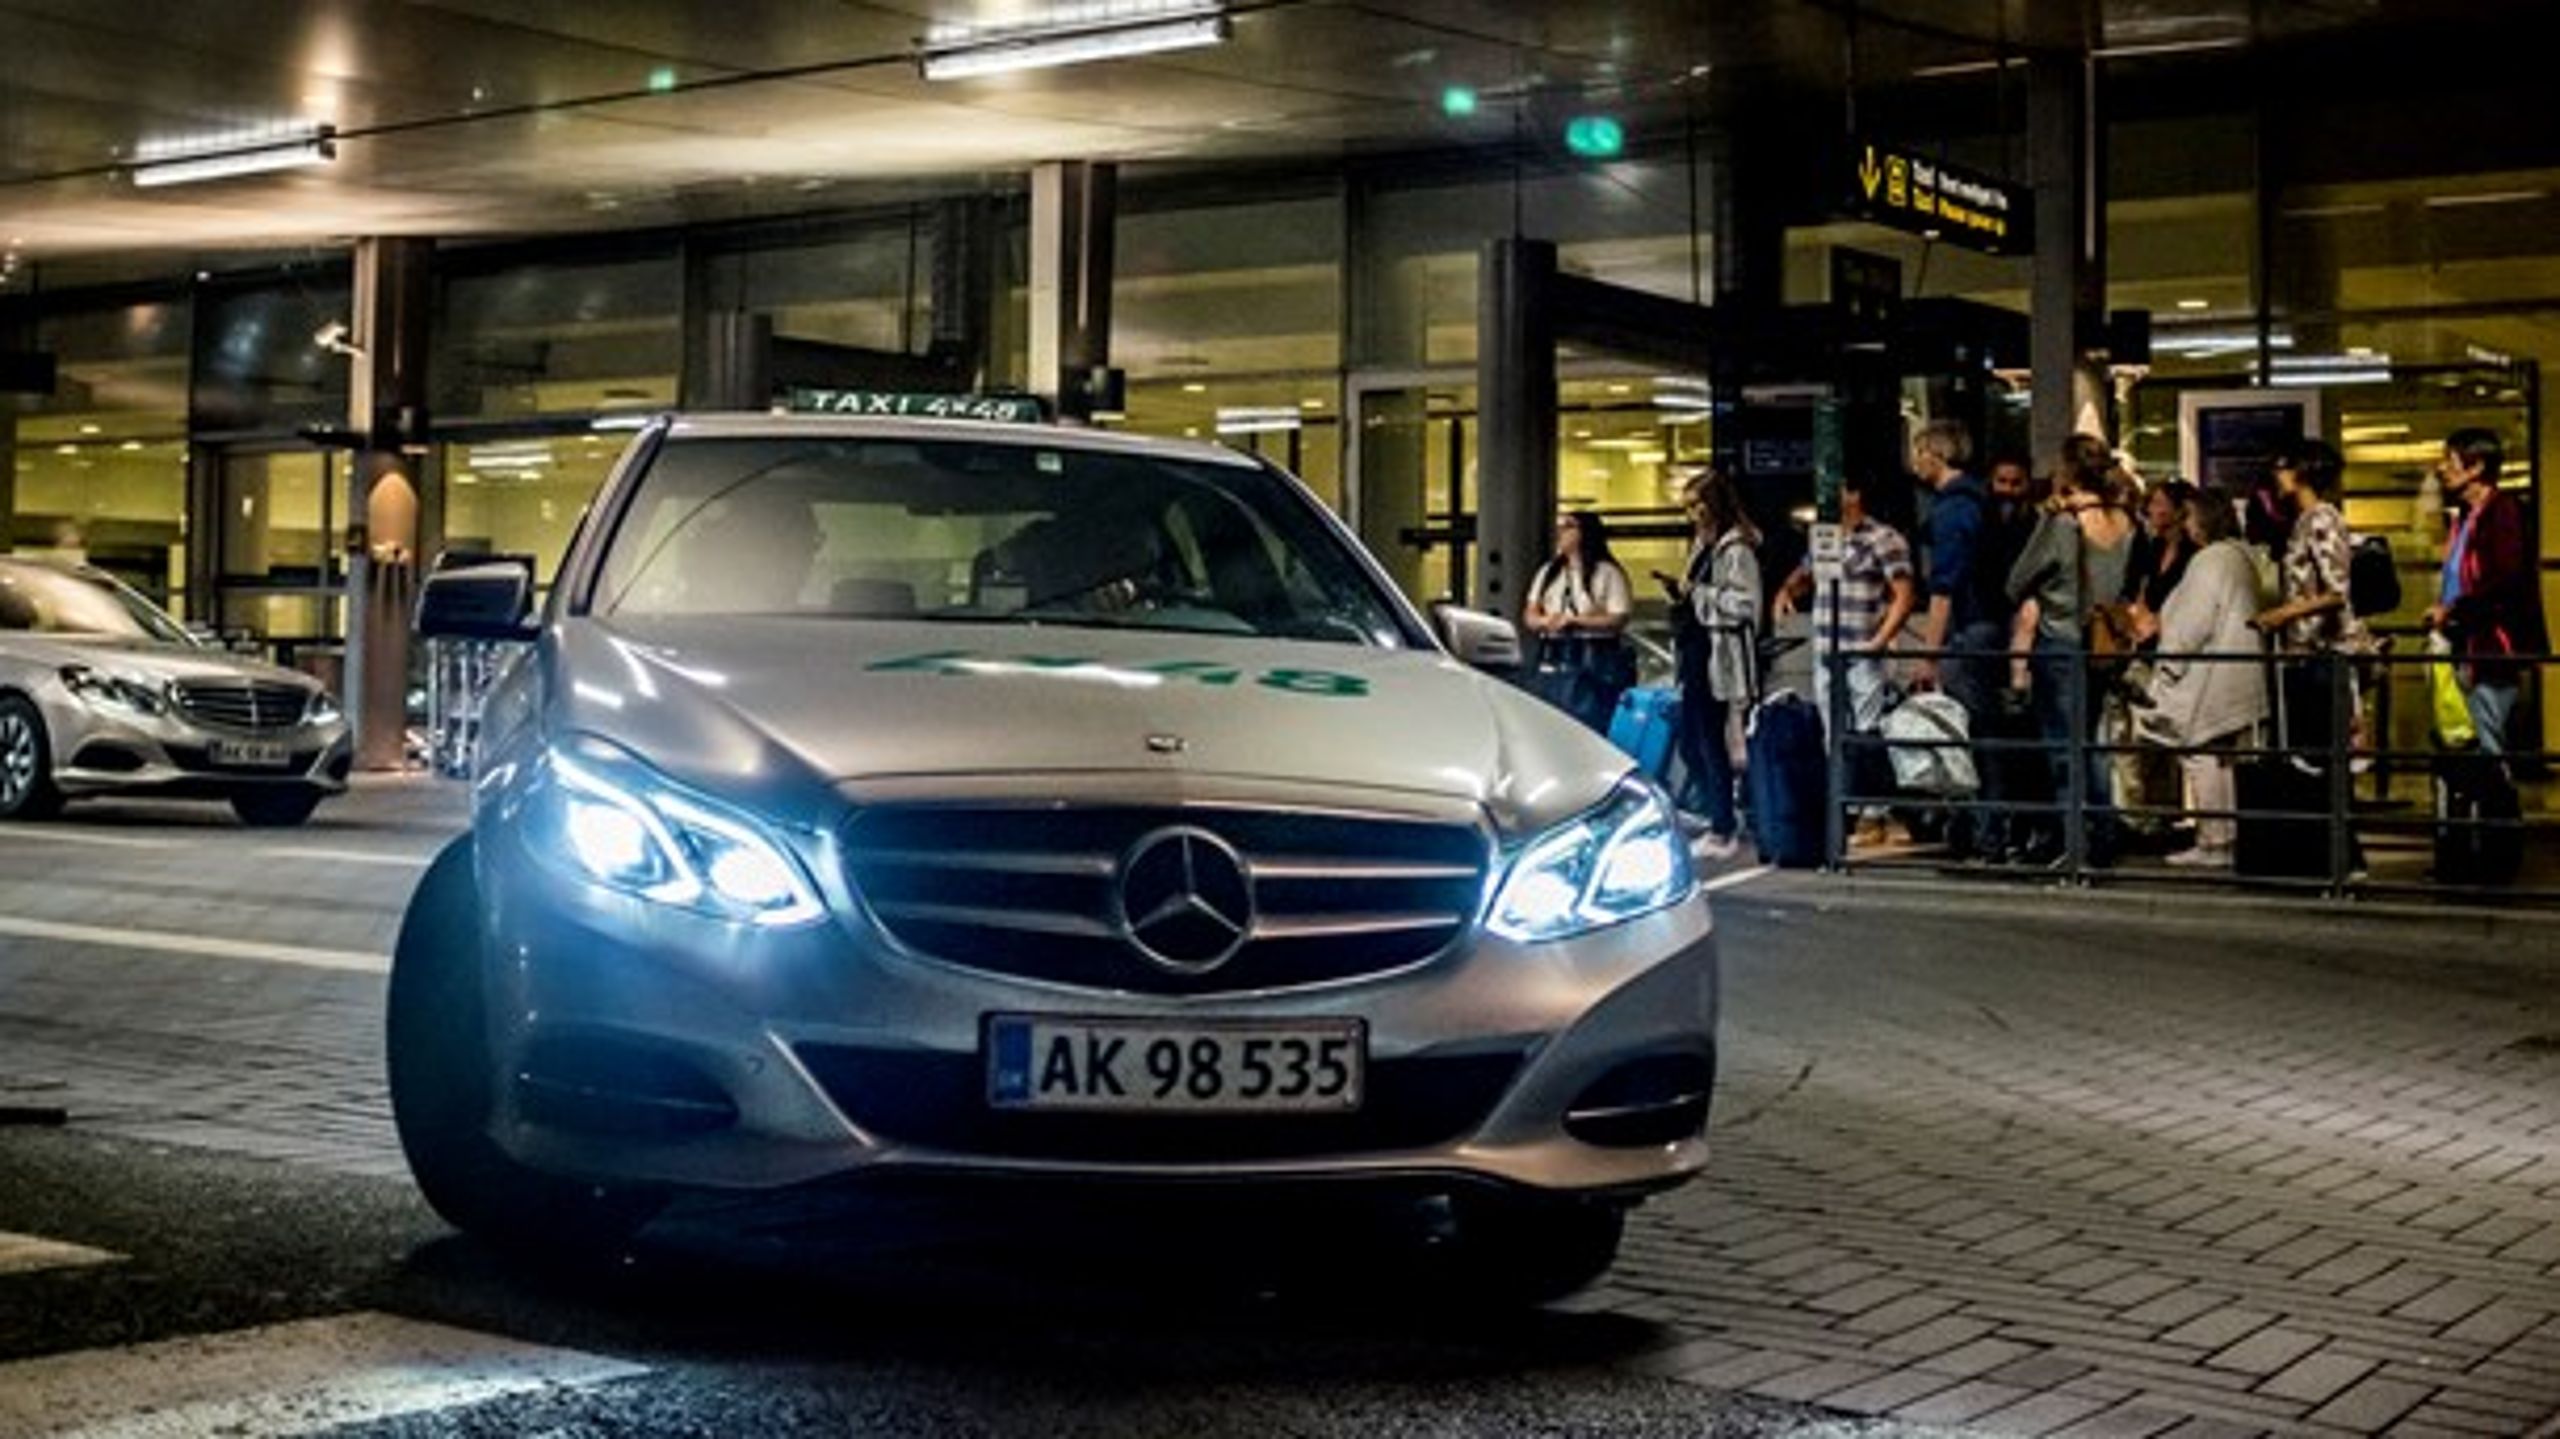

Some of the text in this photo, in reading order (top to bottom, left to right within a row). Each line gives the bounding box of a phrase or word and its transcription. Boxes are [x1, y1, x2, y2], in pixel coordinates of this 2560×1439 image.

[811, 390, 913, 413] TAXI
[1039, 1034, 1349, 1099] AK 98 535
